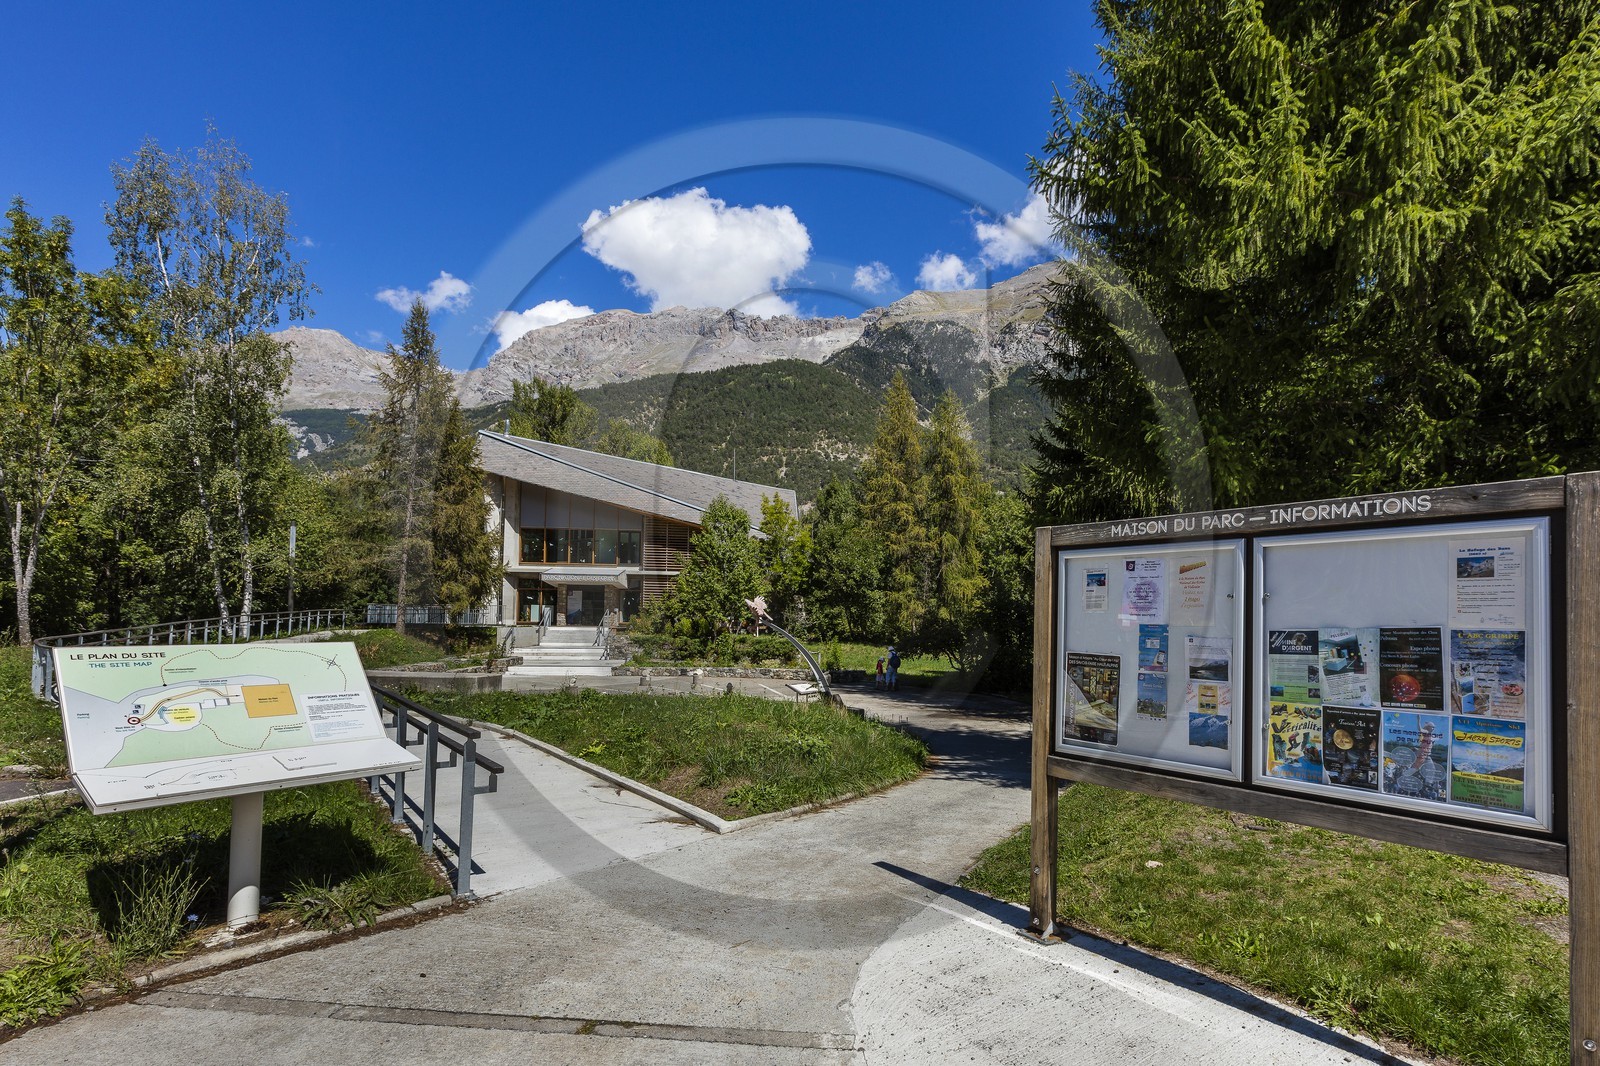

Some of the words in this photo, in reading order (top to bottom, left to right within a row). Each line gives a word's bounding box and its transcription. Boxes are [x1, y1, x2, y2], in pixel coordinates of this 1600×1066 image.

[1111, 520, 1168, 538] MAISON
[1174, 518, 1195, 532] DU
[1202, 513, 1245, 530] PARC
[1270, 495, 1432, 524] INFORMATIONS
